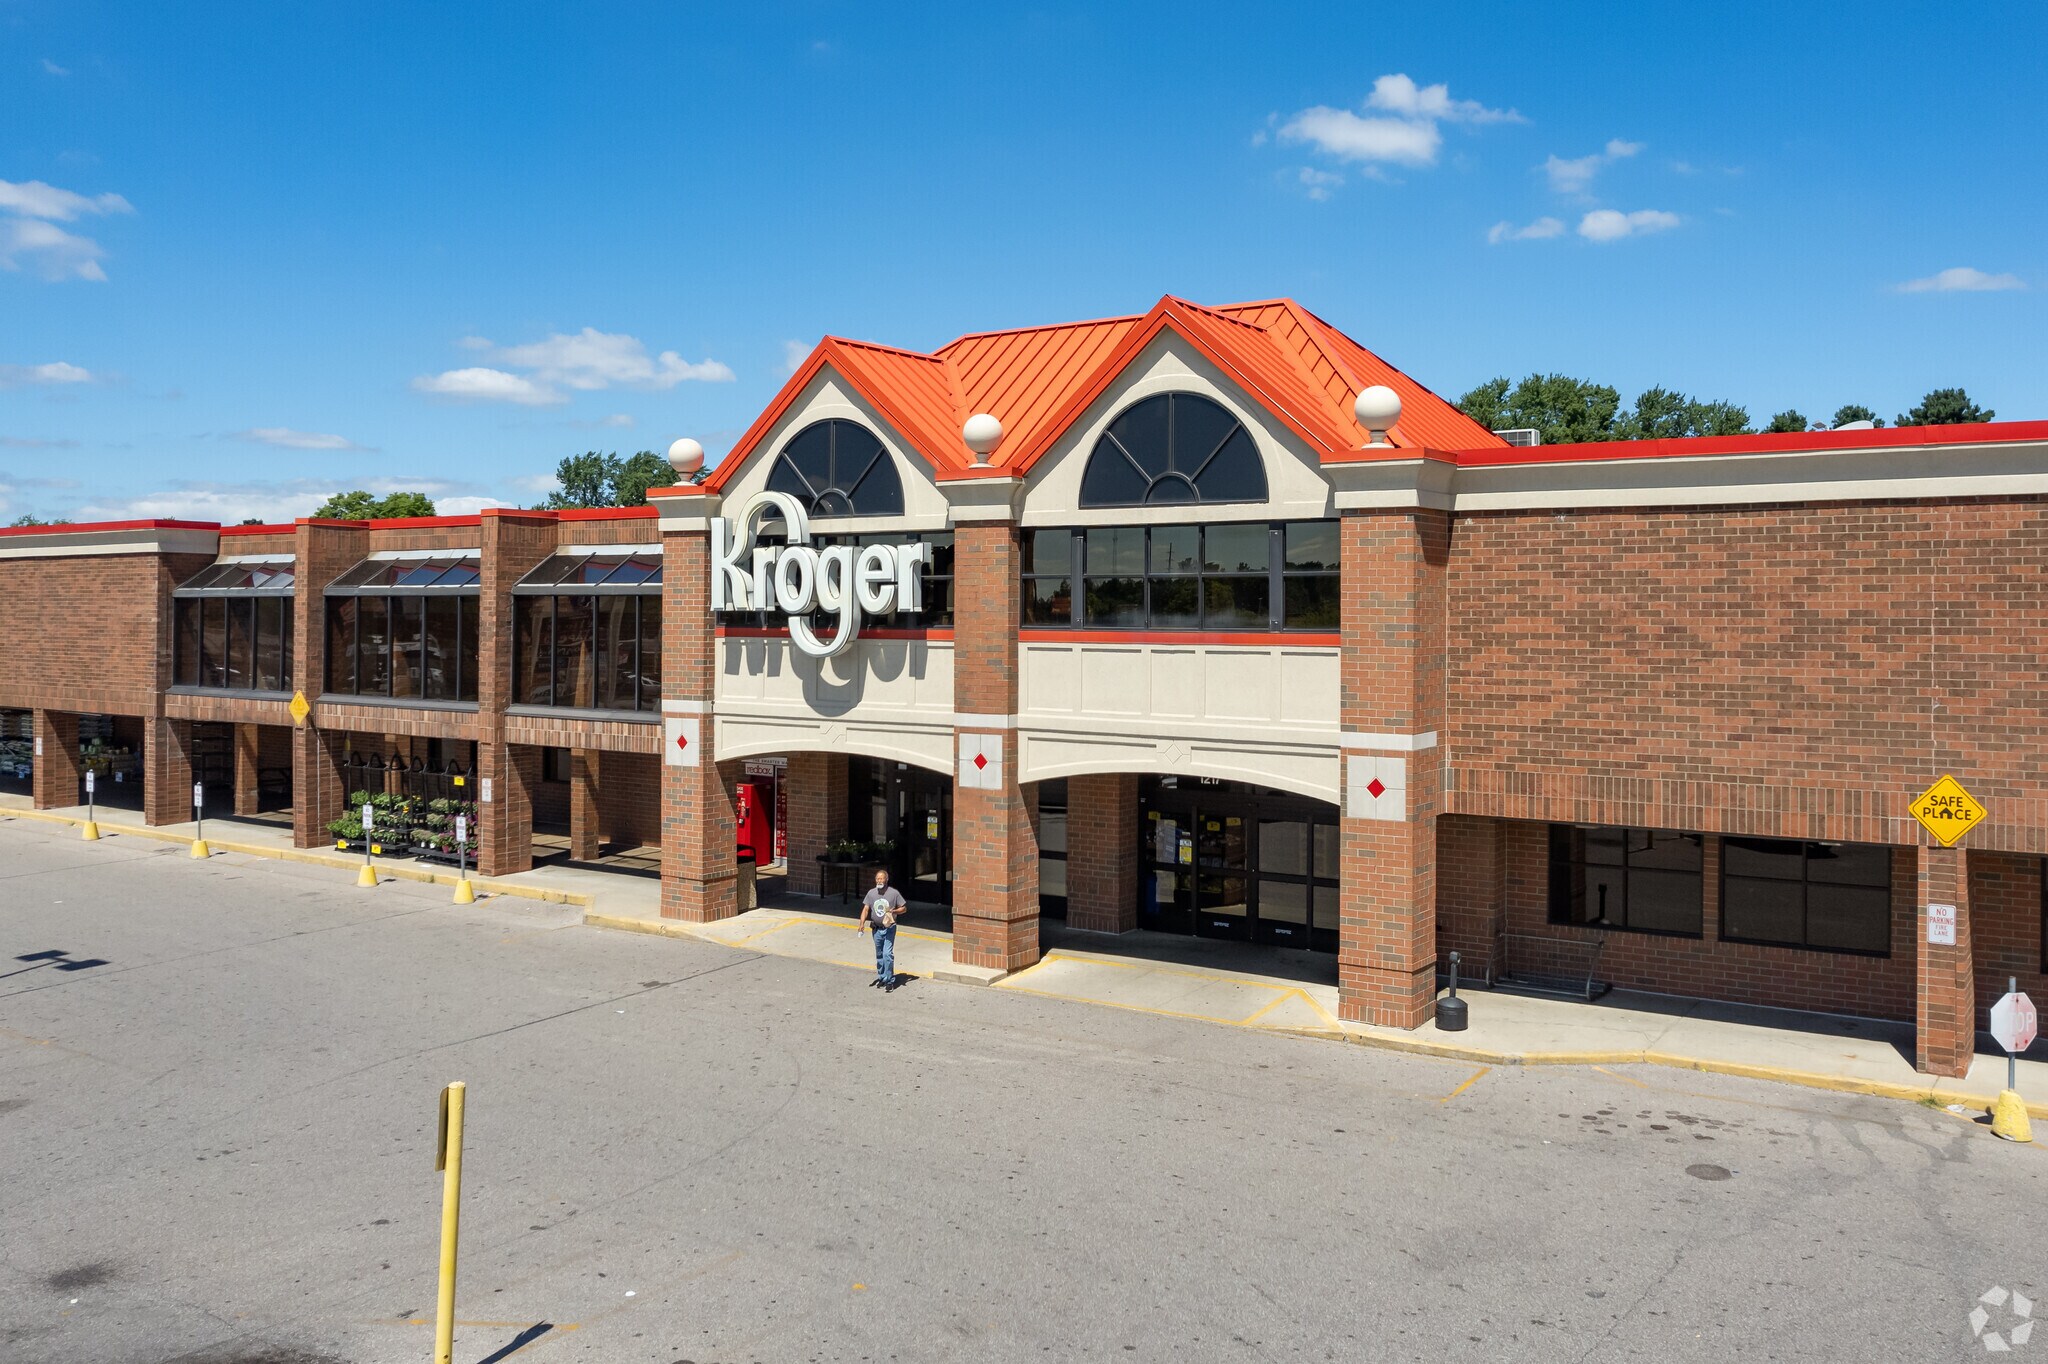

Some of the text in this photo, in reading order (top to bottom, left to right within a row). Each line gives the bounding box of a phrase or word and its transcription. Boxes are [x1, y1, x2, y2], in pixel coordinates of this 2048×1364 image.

[711, 491, 931, 657] Kroger
[1930, 795, 1963, 808] SAFE
[1930, 916, 1954, 925] PARKING
[2007, 1011, 2034, 1033] TOP
